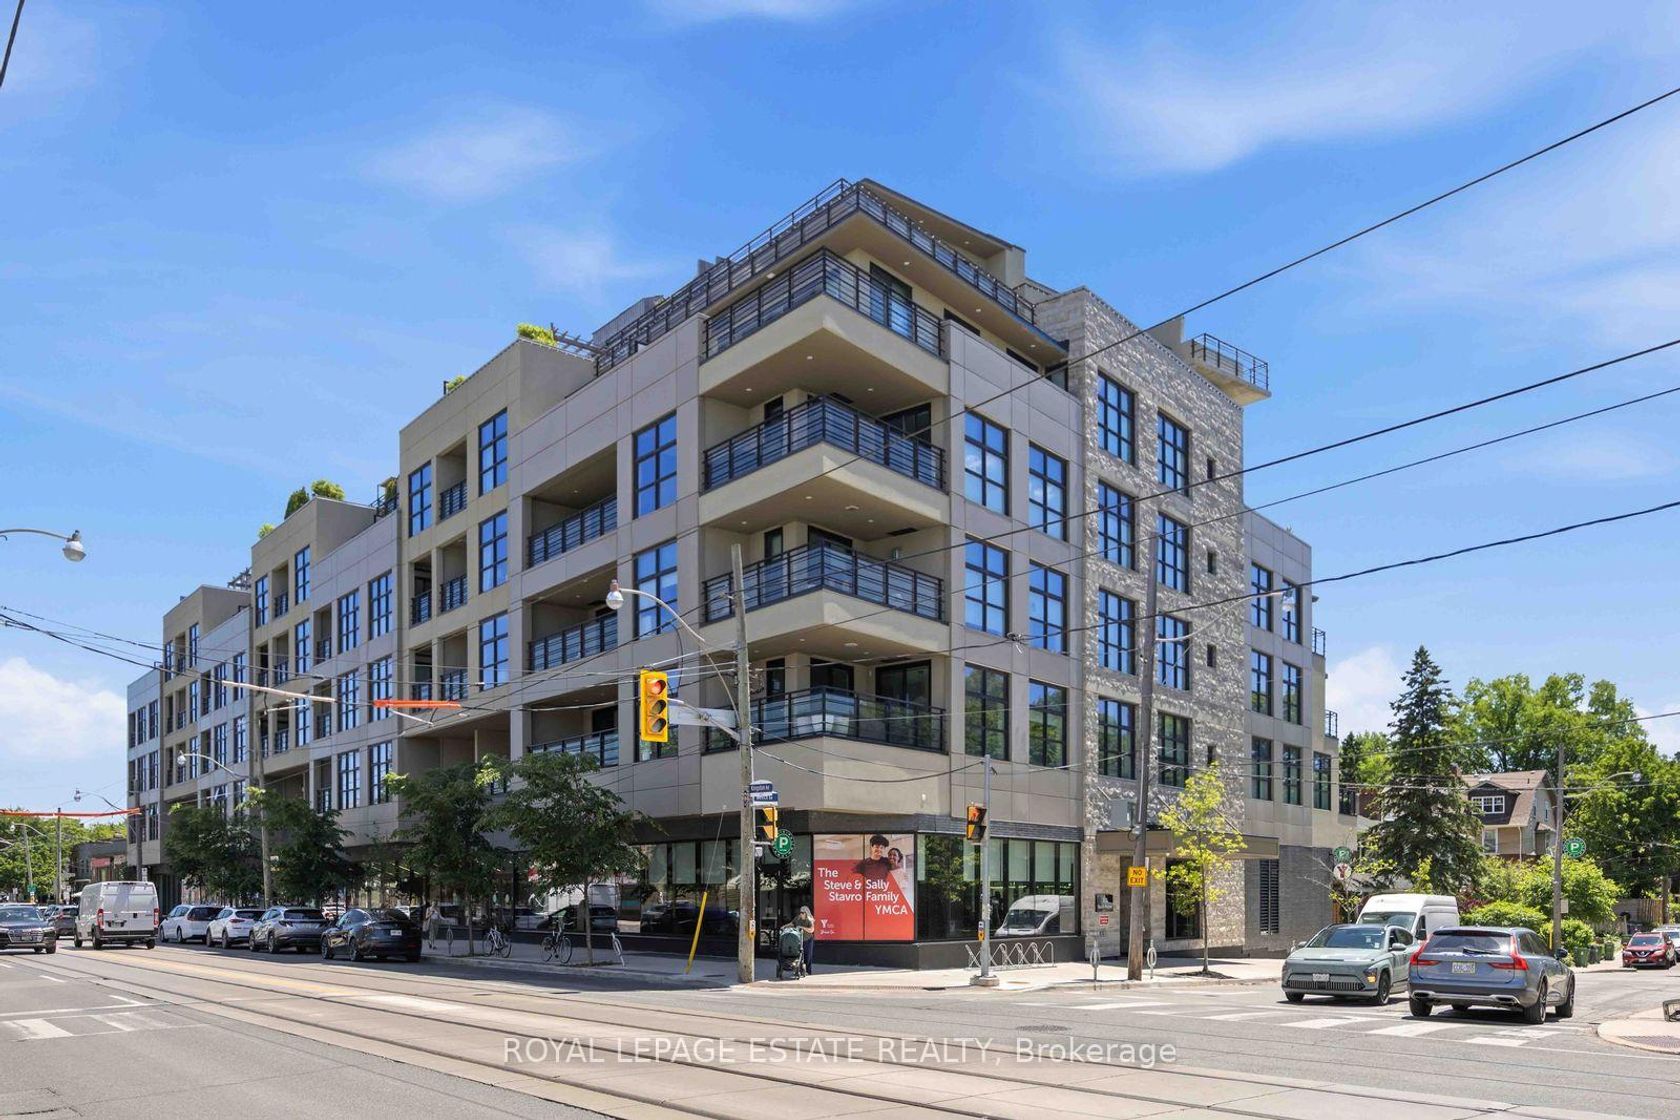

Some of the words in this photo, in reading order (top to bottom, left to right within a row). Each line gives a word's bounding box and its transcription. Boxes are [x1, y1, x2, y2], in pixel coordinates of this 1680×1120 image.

[817, 867, 839, 878] The
[824, 880, 852, 890] Steve
[854, 879, 862, 890] &
[865, 879, 889, 892] Sally
[829, 891, 862, 901] Stavro
[866, 891, 899, 903] Family
[875, 905, 908, 915] YMCA
